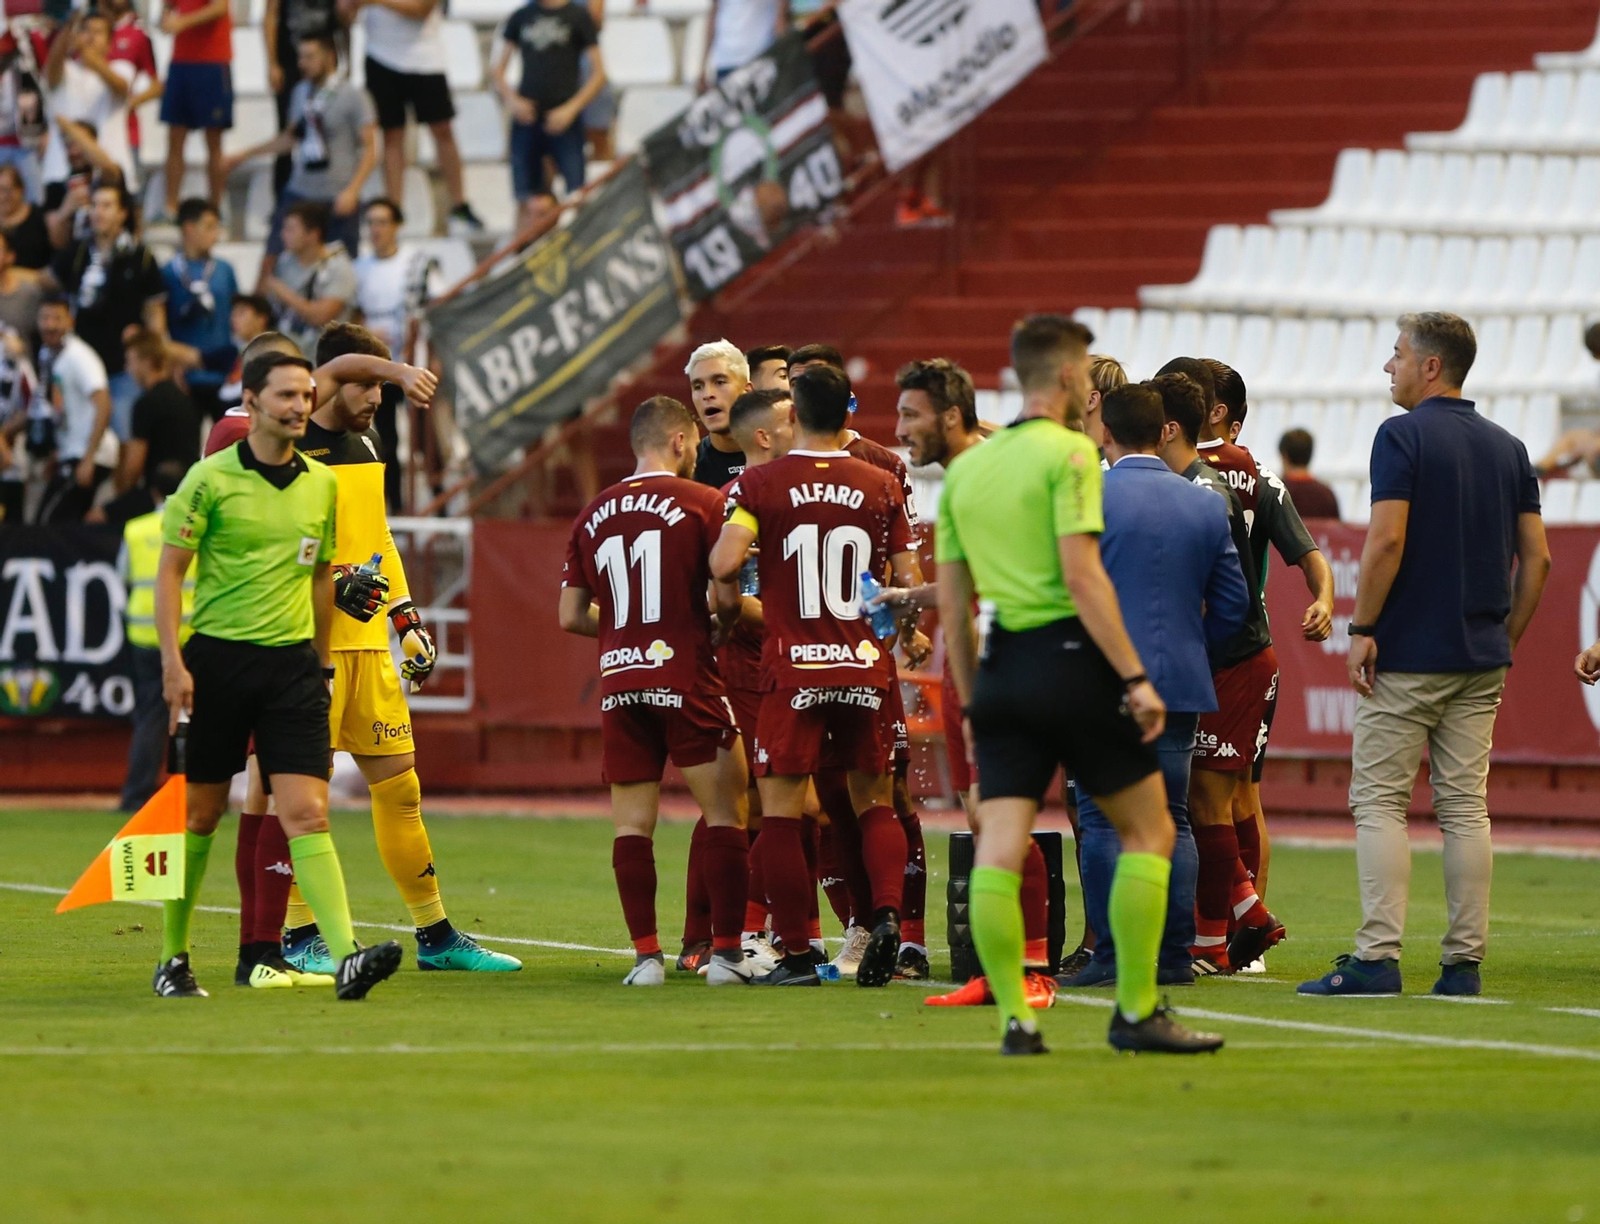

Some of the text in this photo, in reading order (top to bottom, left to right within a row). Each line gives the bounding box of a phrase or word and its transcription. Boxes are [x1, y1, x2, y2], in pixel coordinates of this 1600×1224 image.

[455, 225, 667, 428] ABP-FANS
[788, 482, 865, 510] ALFARO
[1219, 470, 1256, 496] OCK
[584, 493, 687, 539] JAVI GALÁN
[594, 529, 662, 630] 11
[783, 523, 872, 620] 10
[62, 672, 136, 717] 40
[617, 691, 683, 709] HYUNDAI
[818, 690, 882, 711] HYUNDAI
